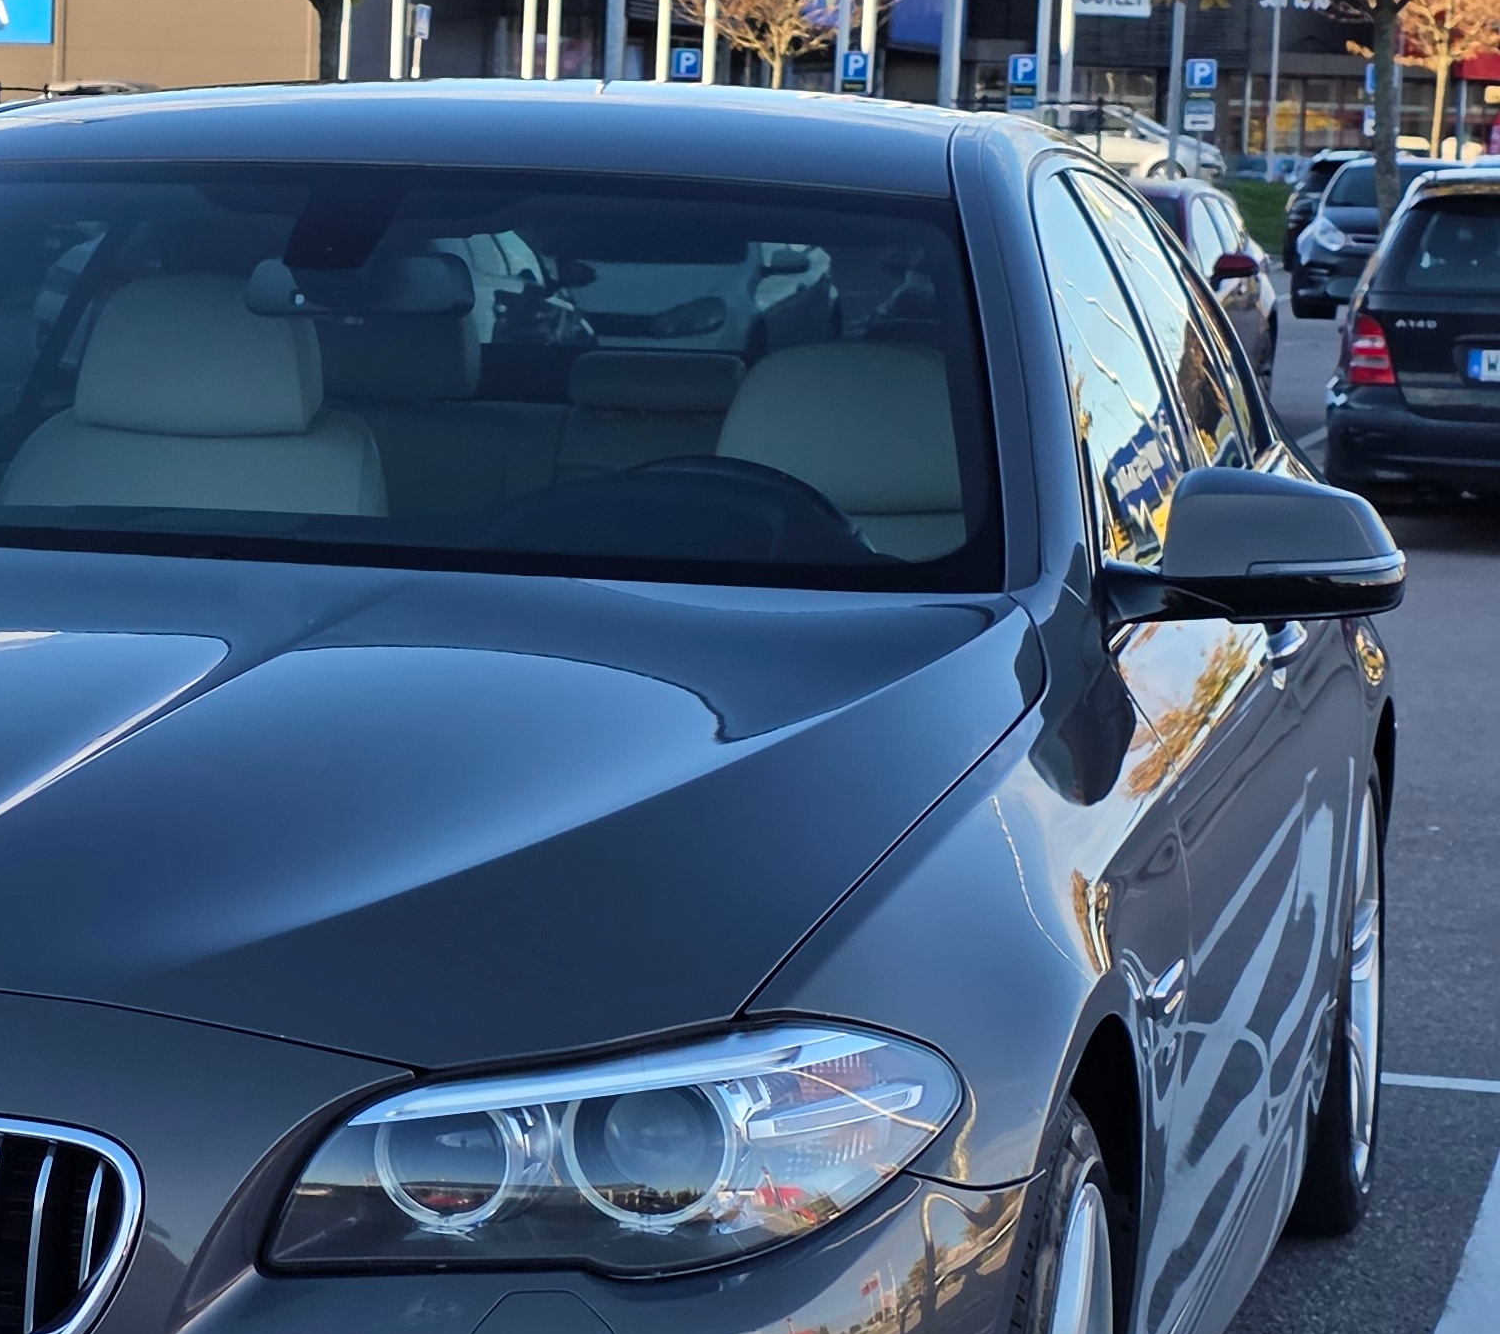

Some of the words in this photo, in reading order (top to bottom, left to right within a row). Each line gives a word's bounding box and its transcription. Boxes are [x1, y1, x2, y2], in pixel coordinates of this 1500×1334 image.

[679, 52, 696, 74] P
[848, 54, 865, 76] P
[1017, 58, 1034, 81] P
[1193, 63, 1211, 85] P
